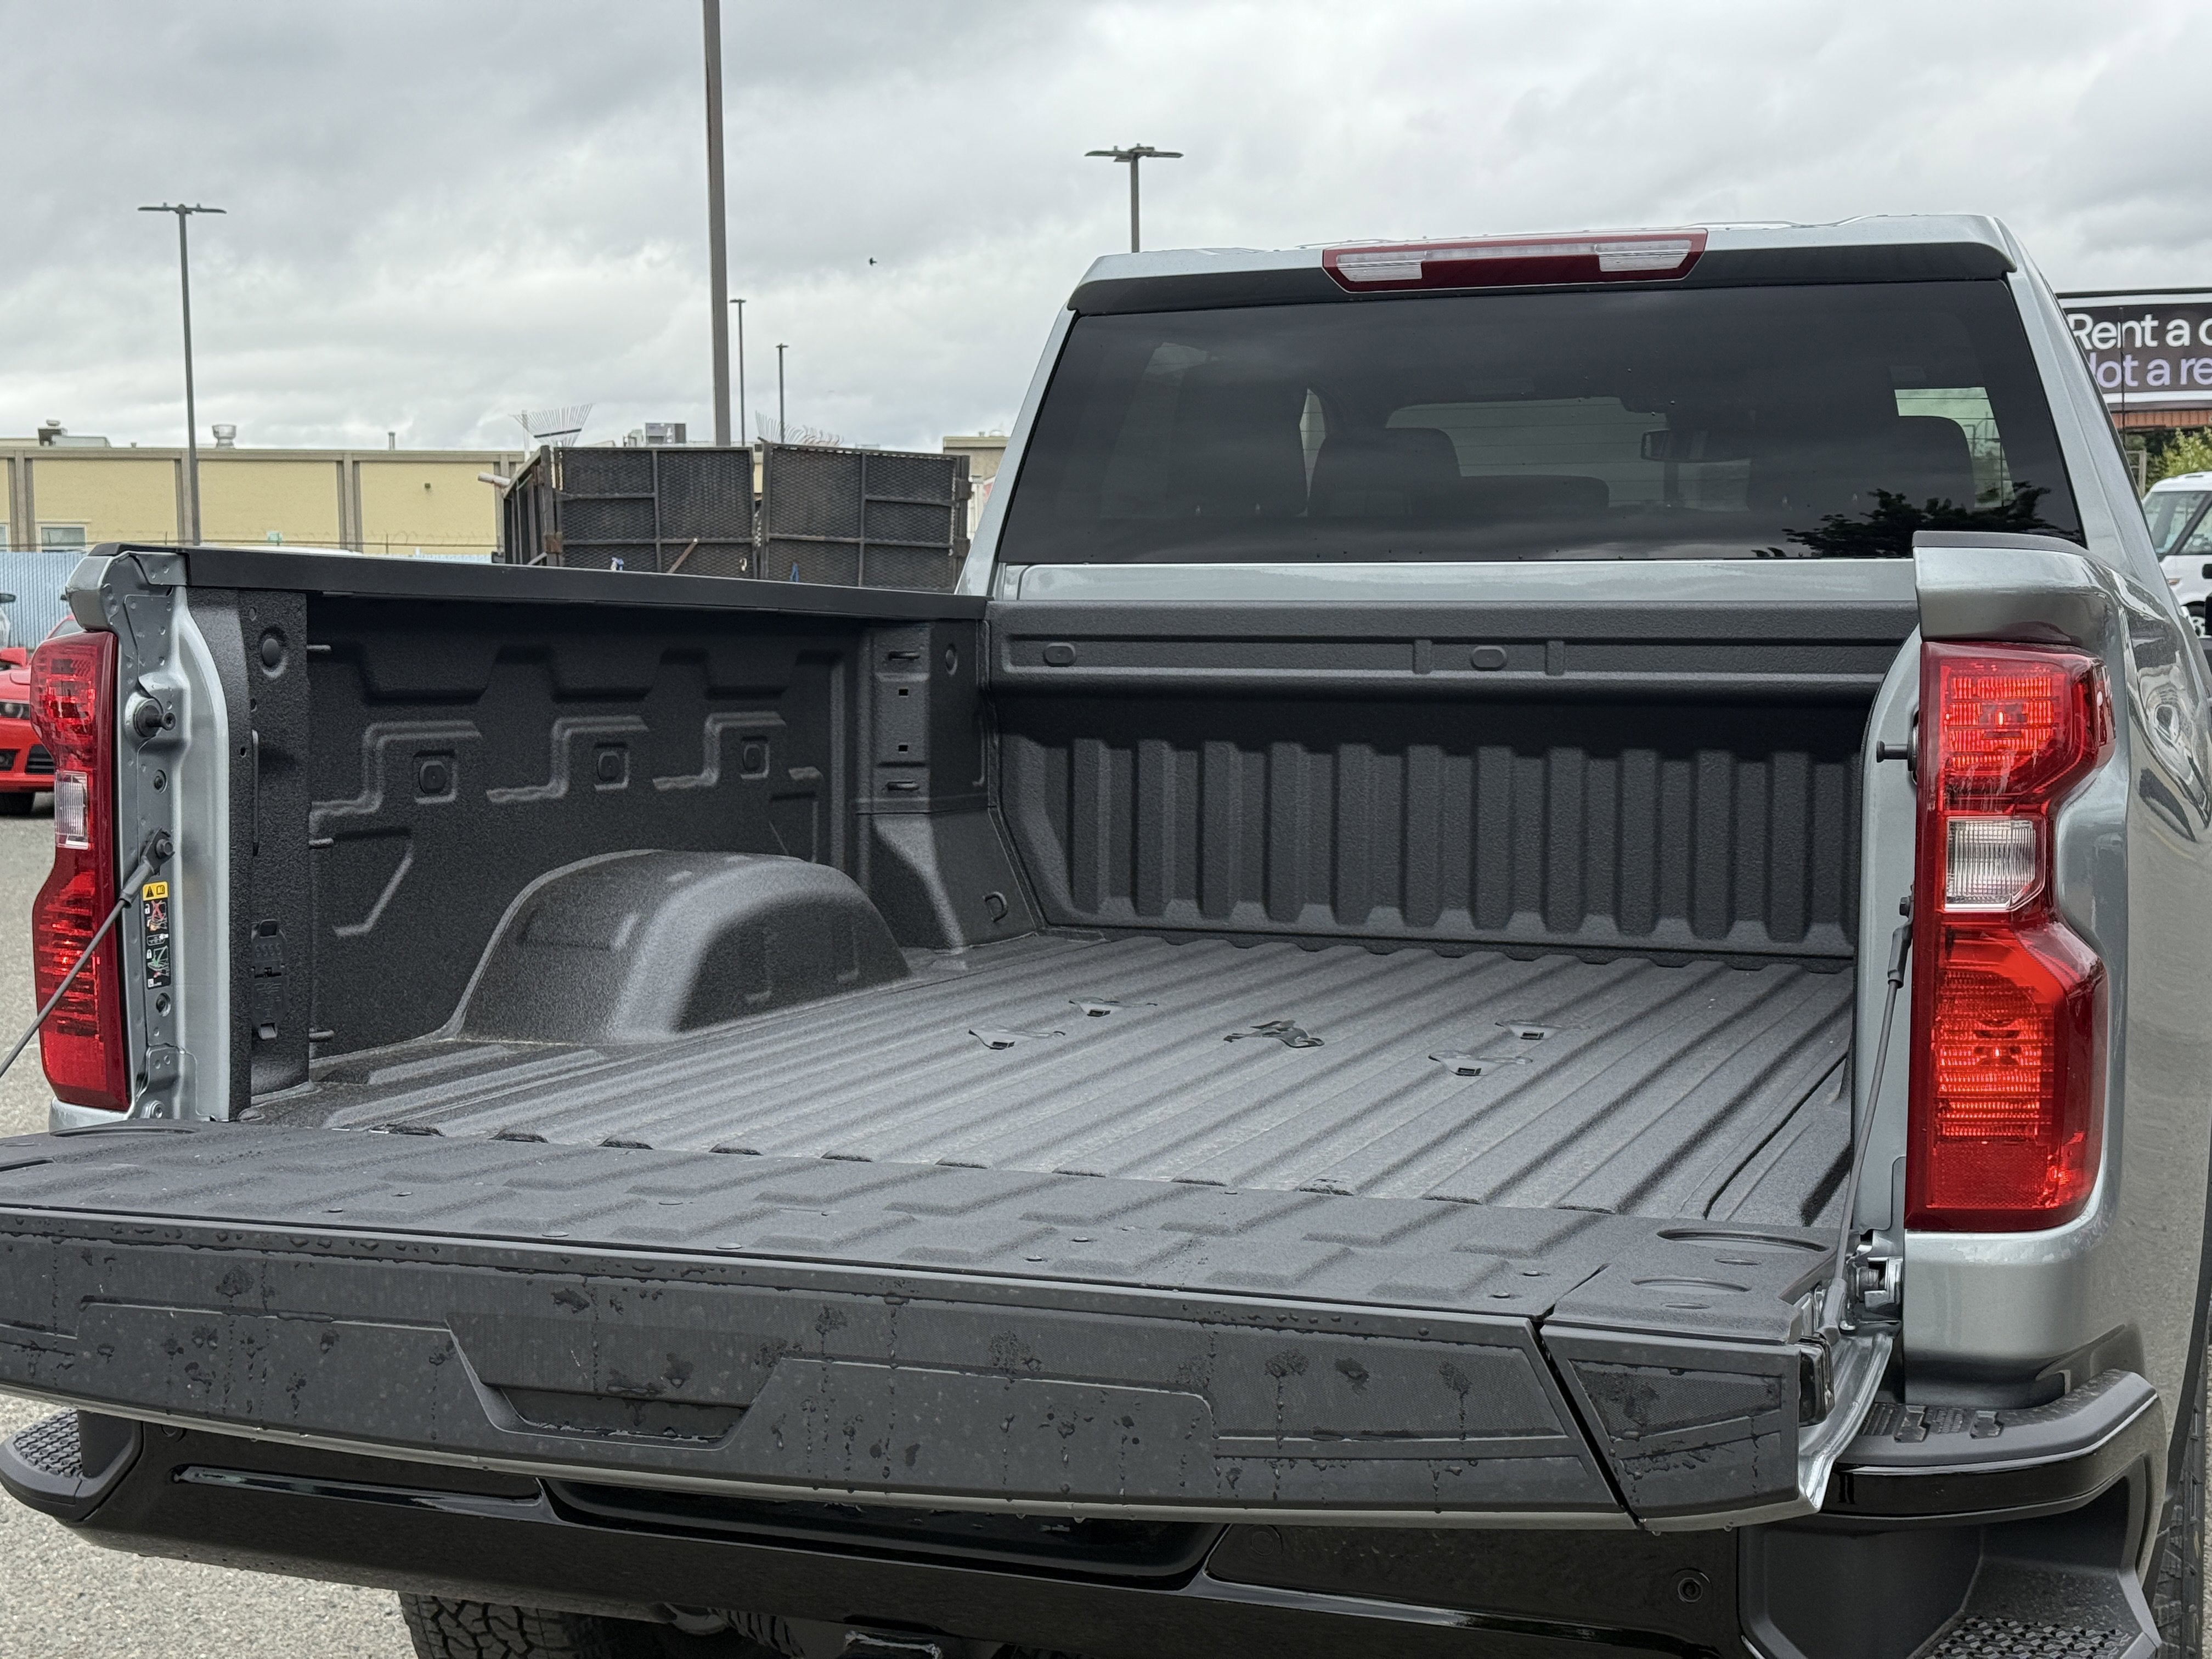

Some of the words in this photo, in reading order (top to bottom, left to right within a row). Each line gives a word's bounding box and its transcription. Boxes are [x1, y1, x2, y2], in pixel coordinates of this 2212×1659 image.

[2067, 313, 2159, 350] Rent
[2166, 319, 2190, 347] a
[2146, 358, 2170, 386] a
[2180, 357, 2212, 385] re
